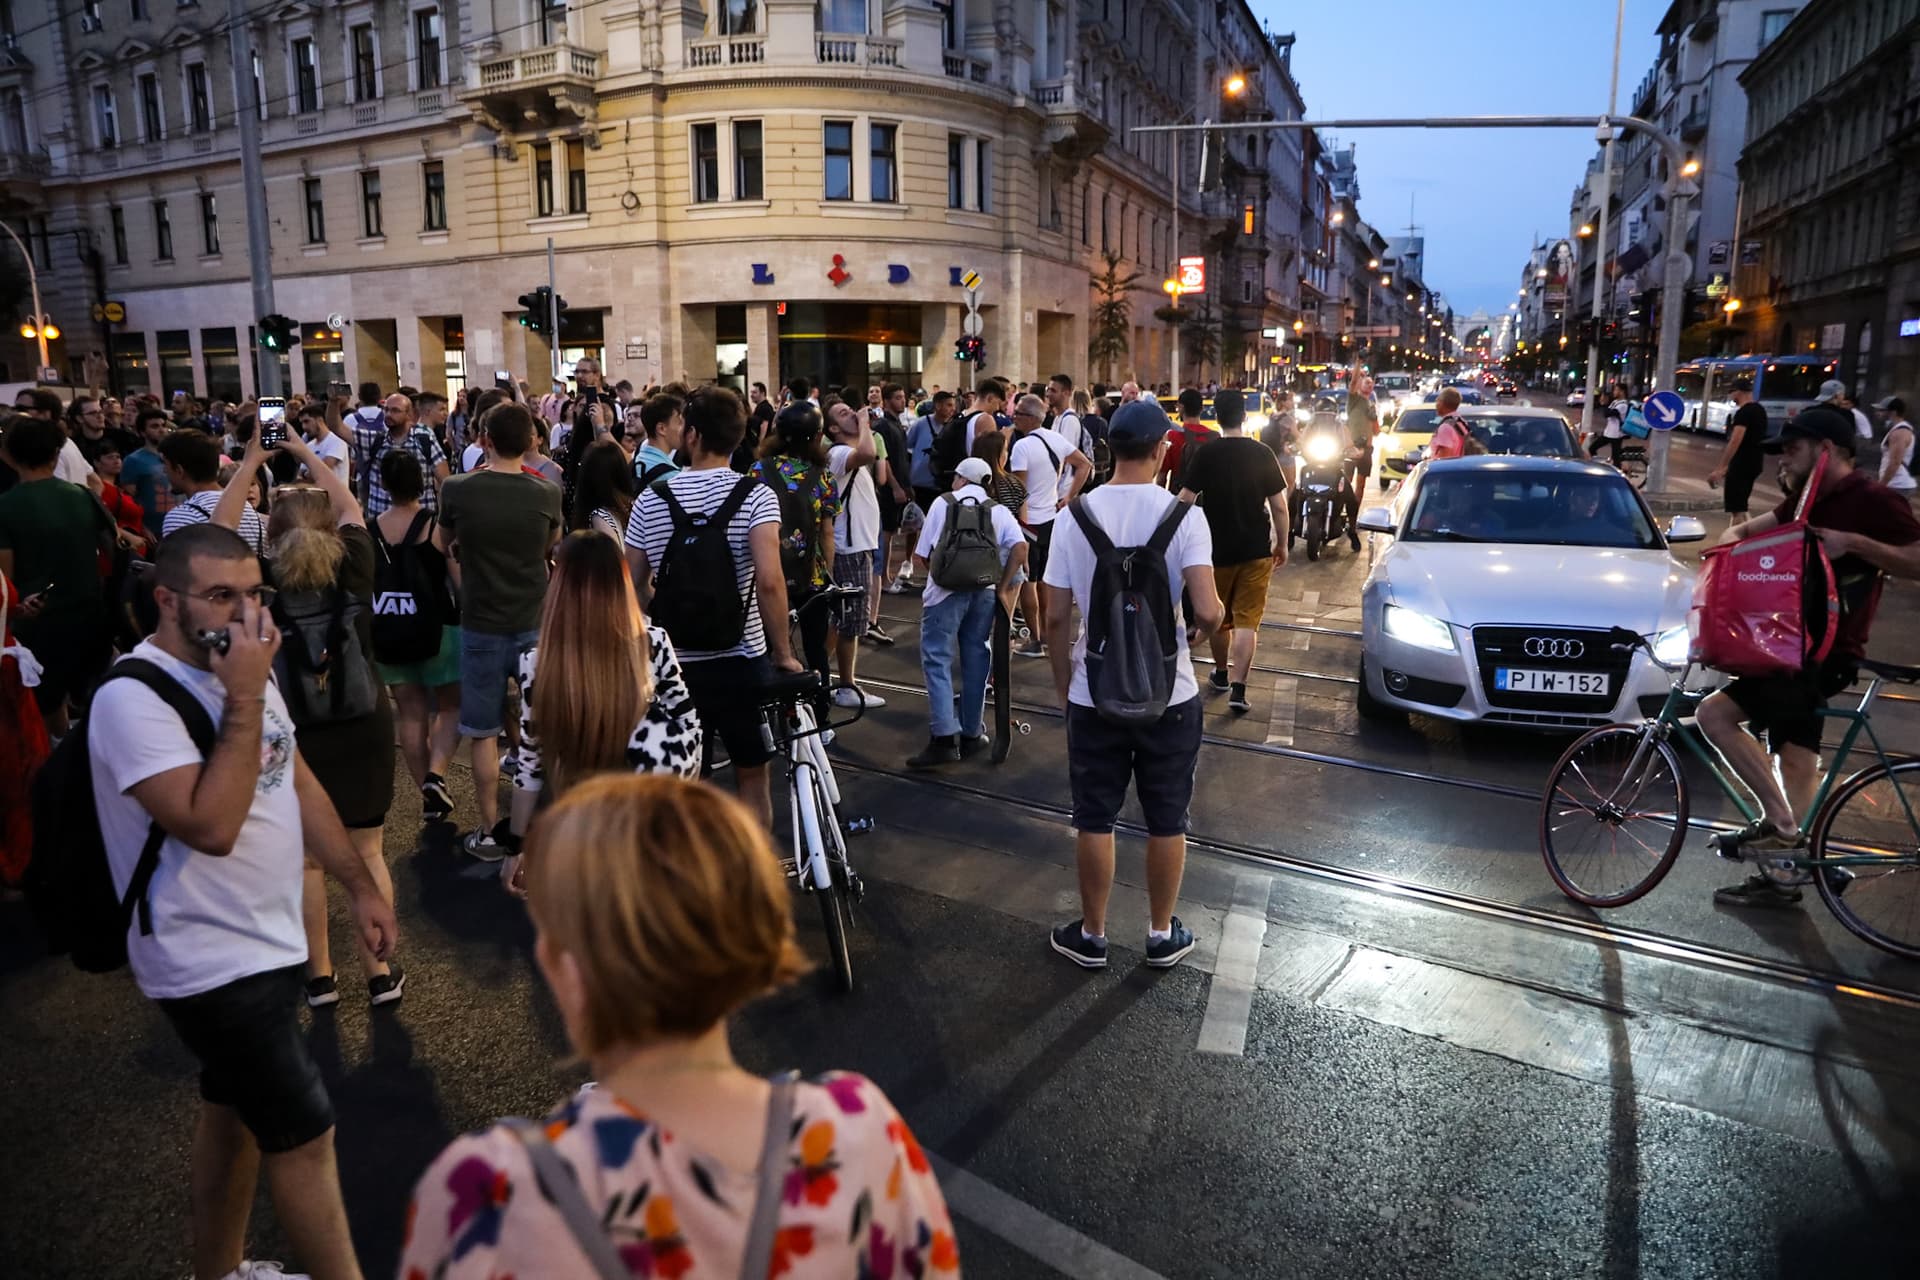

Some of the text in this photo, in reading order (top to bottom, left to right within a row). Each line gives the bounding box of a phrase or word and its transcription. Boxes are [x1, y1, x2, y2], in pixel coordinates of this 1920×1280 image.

[1737, 571, 1796, 583] foodpanda
[372, 591, 418, 615] VAN
[1511, 671, 1603, 693] PIW-152
